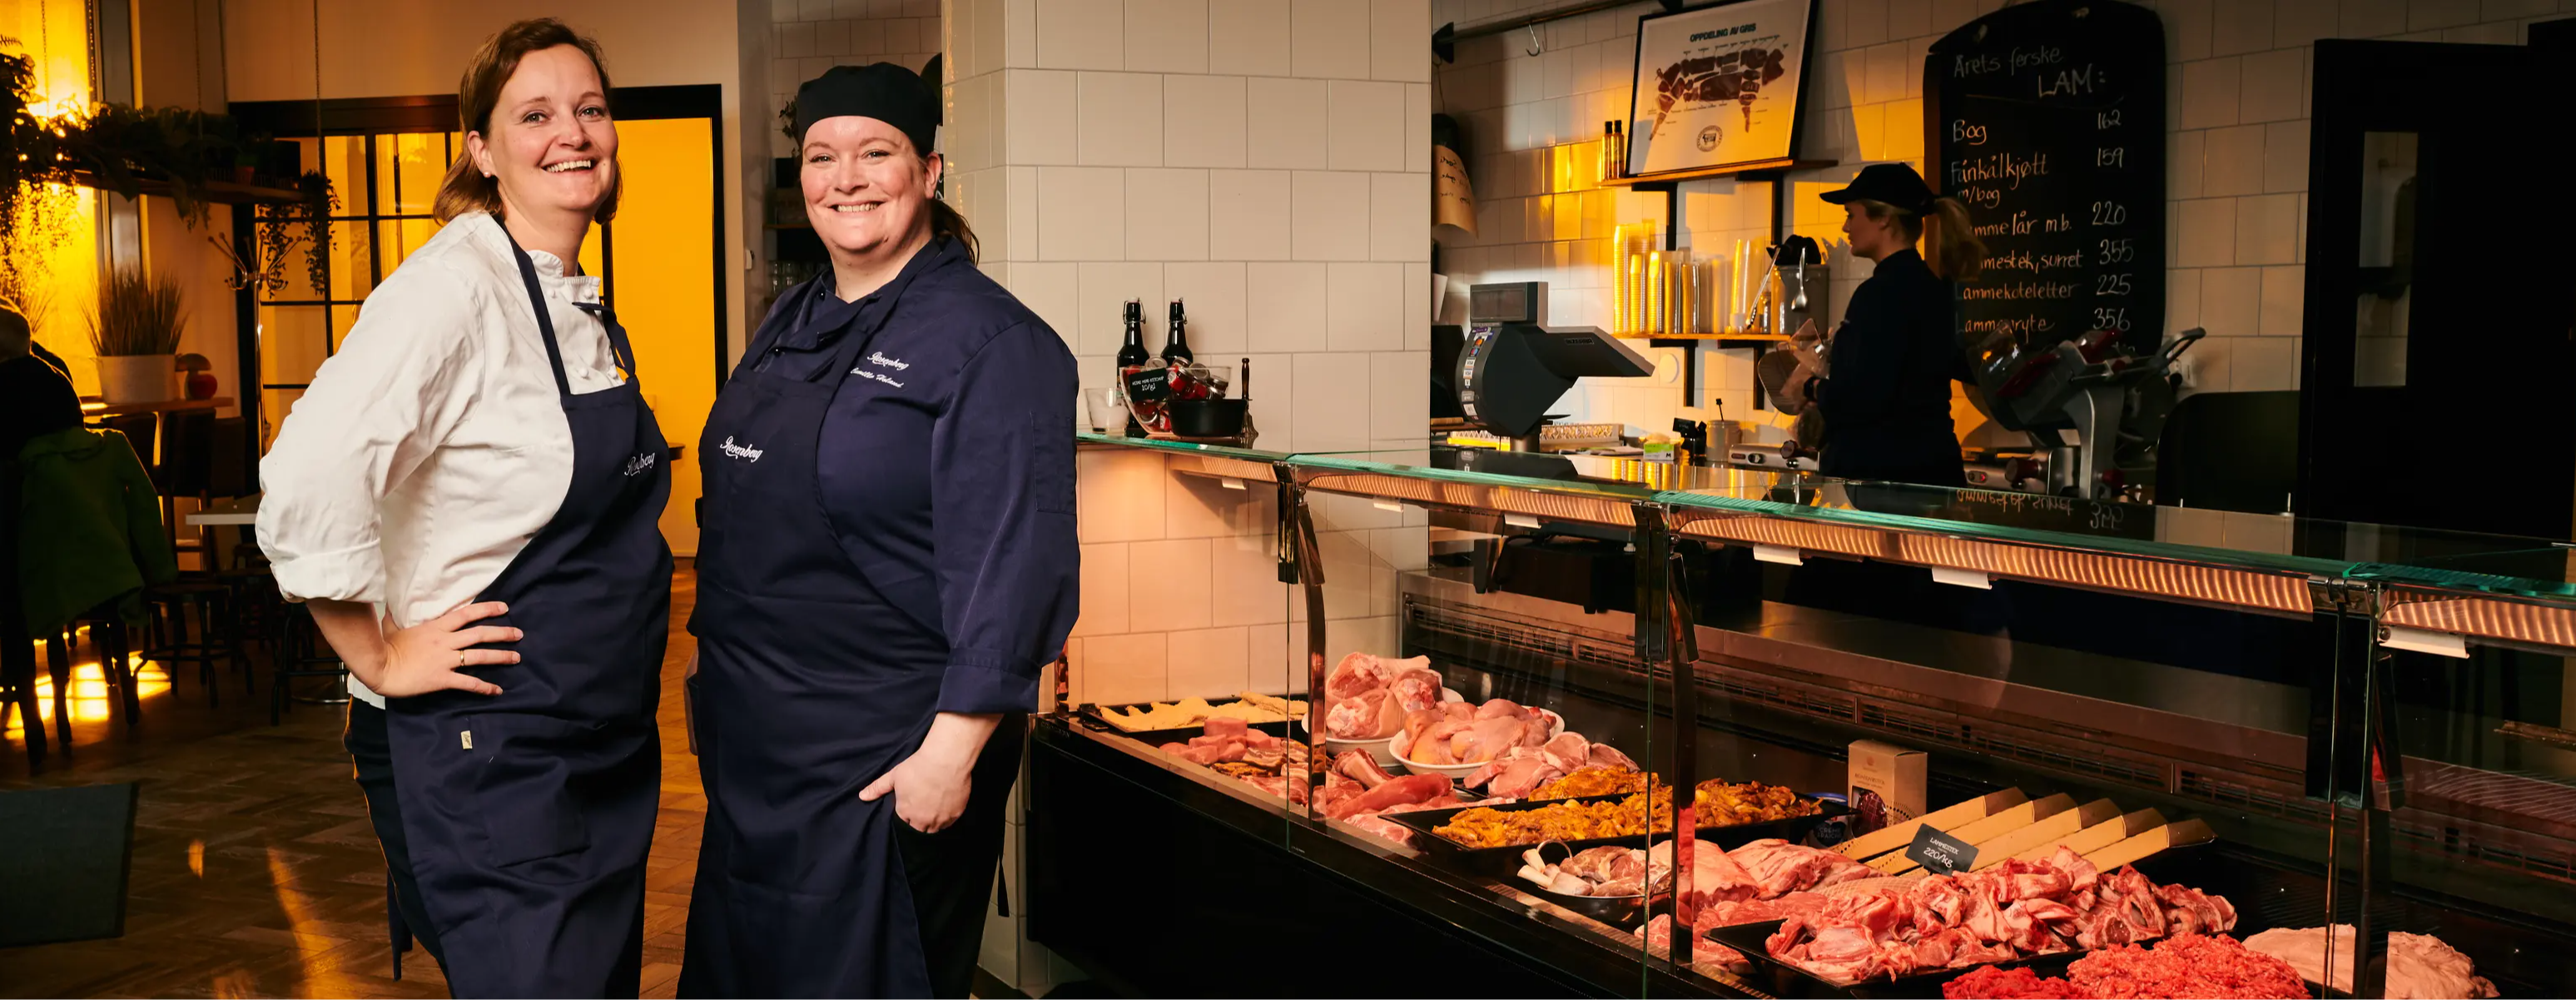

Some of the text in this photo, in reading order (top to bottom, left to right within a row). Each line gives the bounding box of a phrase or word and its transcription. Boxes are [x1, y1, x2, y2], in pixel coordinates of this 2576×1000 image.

[1953, 46, 2065, 78] Årets ferske
[1953, 109, 2122, 146] Bog 162
[2097, 147, 2123, 167] 159
[2092, 201, 2126, 225] 220
[2099, 239, 2133, 265] 355
[2096, 274, 2132, 296] 225
[2092, 307, 2131, 331] 356
[720, 435, 763, 462] Rosenberg
